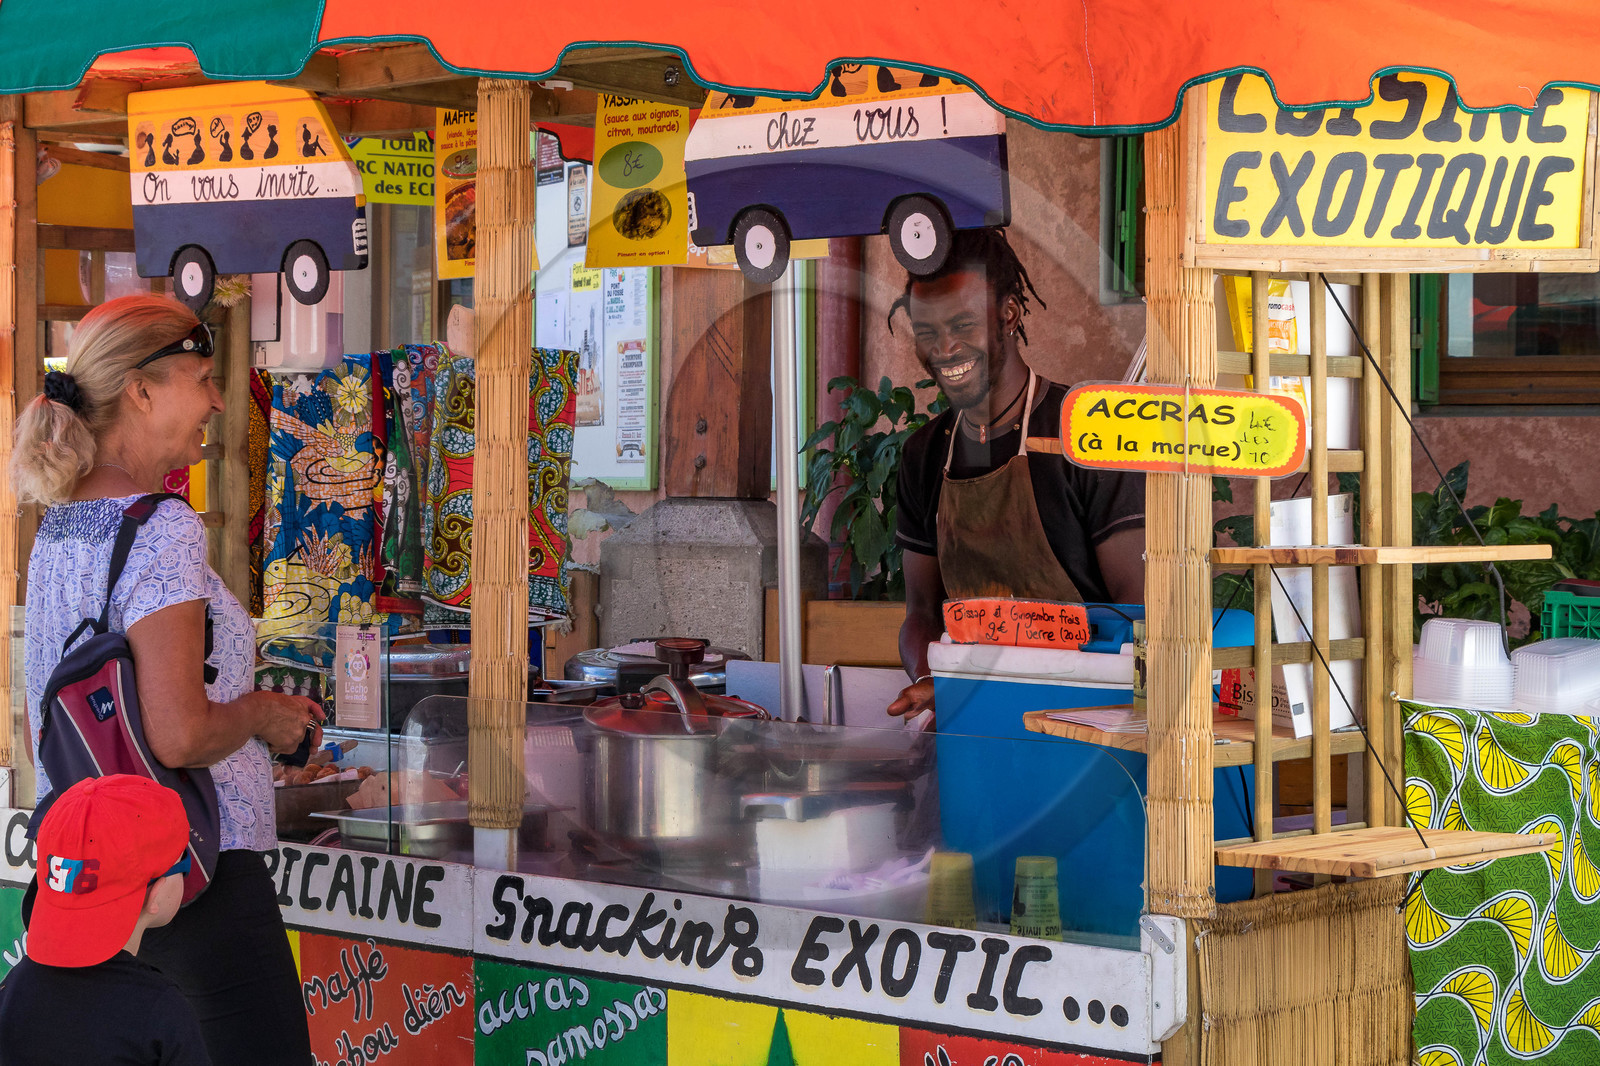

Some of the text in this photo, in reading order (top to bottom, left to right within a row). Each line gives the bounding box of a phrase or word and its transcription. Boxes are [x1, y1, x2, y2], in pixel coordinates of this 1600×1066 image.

[603, 109, 681, 126] (sauce aux oignons,
[606, 120, 680, 138] citron, moutarde)
[853, 106, 920, 142] vous
[623, 150, 645, 177] 8€
[143, 172, 171, 204] On
[191, 174, 240, 202] vous
[375, 180, 403, 195] des
[1213, 150, 1575, 246] EXOTIQUE
[1086, 397, 1236, 425] ACCRAS
[1078, 432, 1242, 462] (à la morue)
[948, 602, 986, 626] Bissap
[1010, 605, 1055, 628] Gingembre
[1059, 608, 1080, 626] frais
[985, 621, 1008, 642] 2€
[1025, 628, 1056, 642] verre
[484, 873, 765, 979] Snacking
[478, 976, 591, 1037] accras
